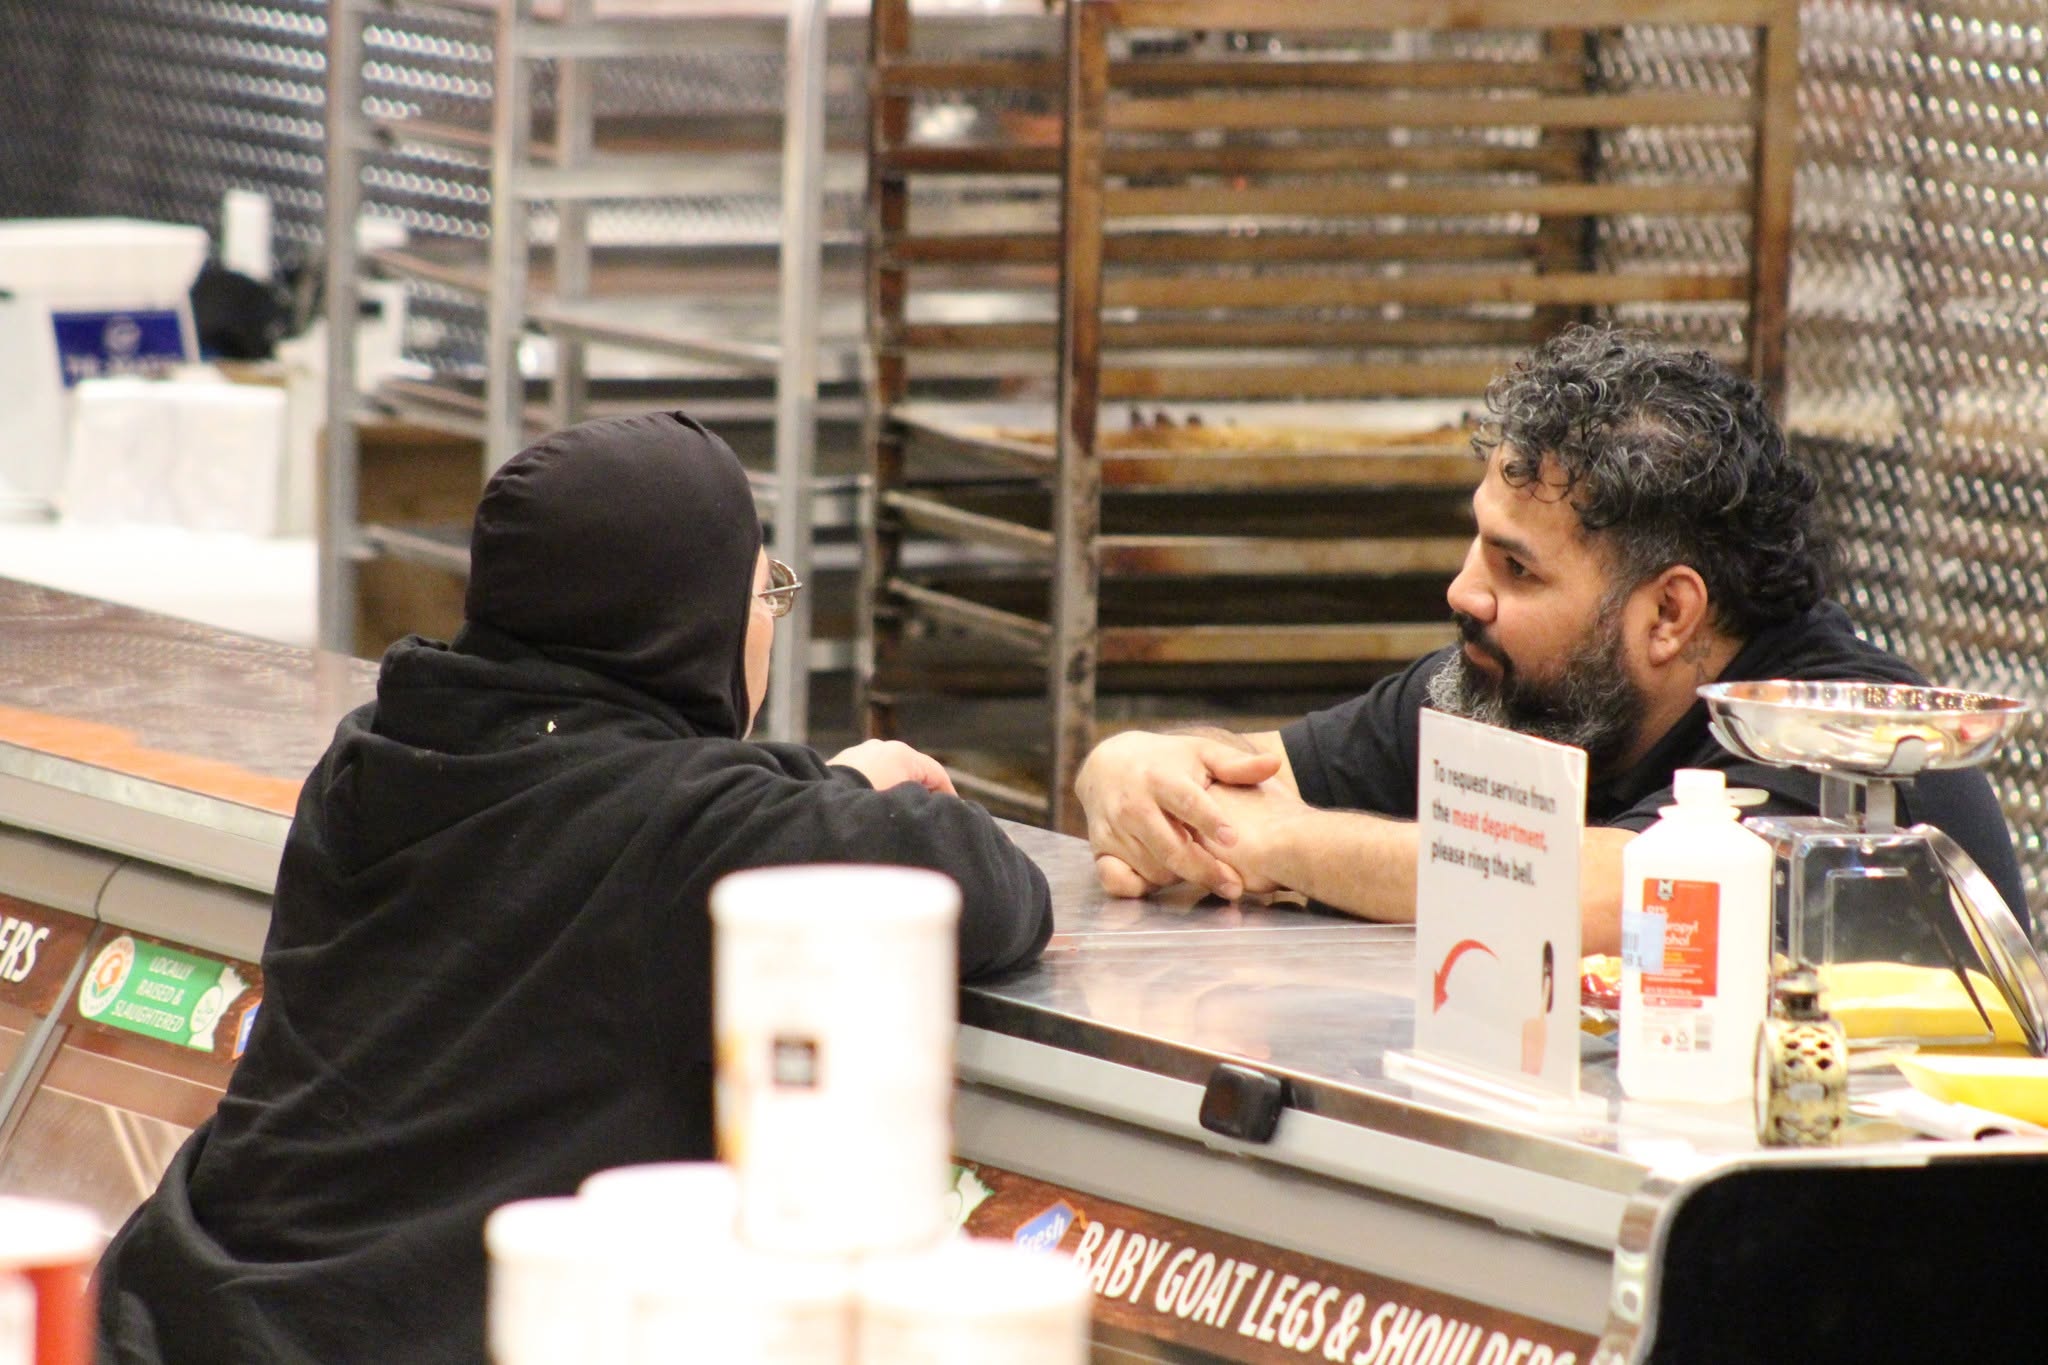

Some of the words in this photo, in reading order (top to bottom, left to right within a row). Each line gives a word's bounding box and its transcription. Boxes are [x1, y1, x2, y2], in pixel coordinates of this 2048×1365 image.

[1433, 759, 1445, 783] To
[1448, 768, 1488, 795] request
[1491, 780, 1528, 806] service
[1530, 785, 1556, 814] from
[1432, 798, 1449, 823] the
[1452, 808, 1480, 832] meat
[1432, 836, 1466, 867] please
[1468, 848, 1489, 879] ring
[1493, 853, 1509, 878] the
[1512, 859, 1536, 886] bell.
[0, 915, 50, 984] ERS
[149, 955, 195, 981] LOCALLY
[136, 978, 176, 1004] RAISED
[111, 999, 185, 1033] SLAUGHTERED
[1073, 1220, 1172, 1304] BABY
[1155, 1246, 1258, 1329] GOAT
[1237, 1268, 1341, 1353] LEGS
[1322, 1292, 1366, 1363] &
